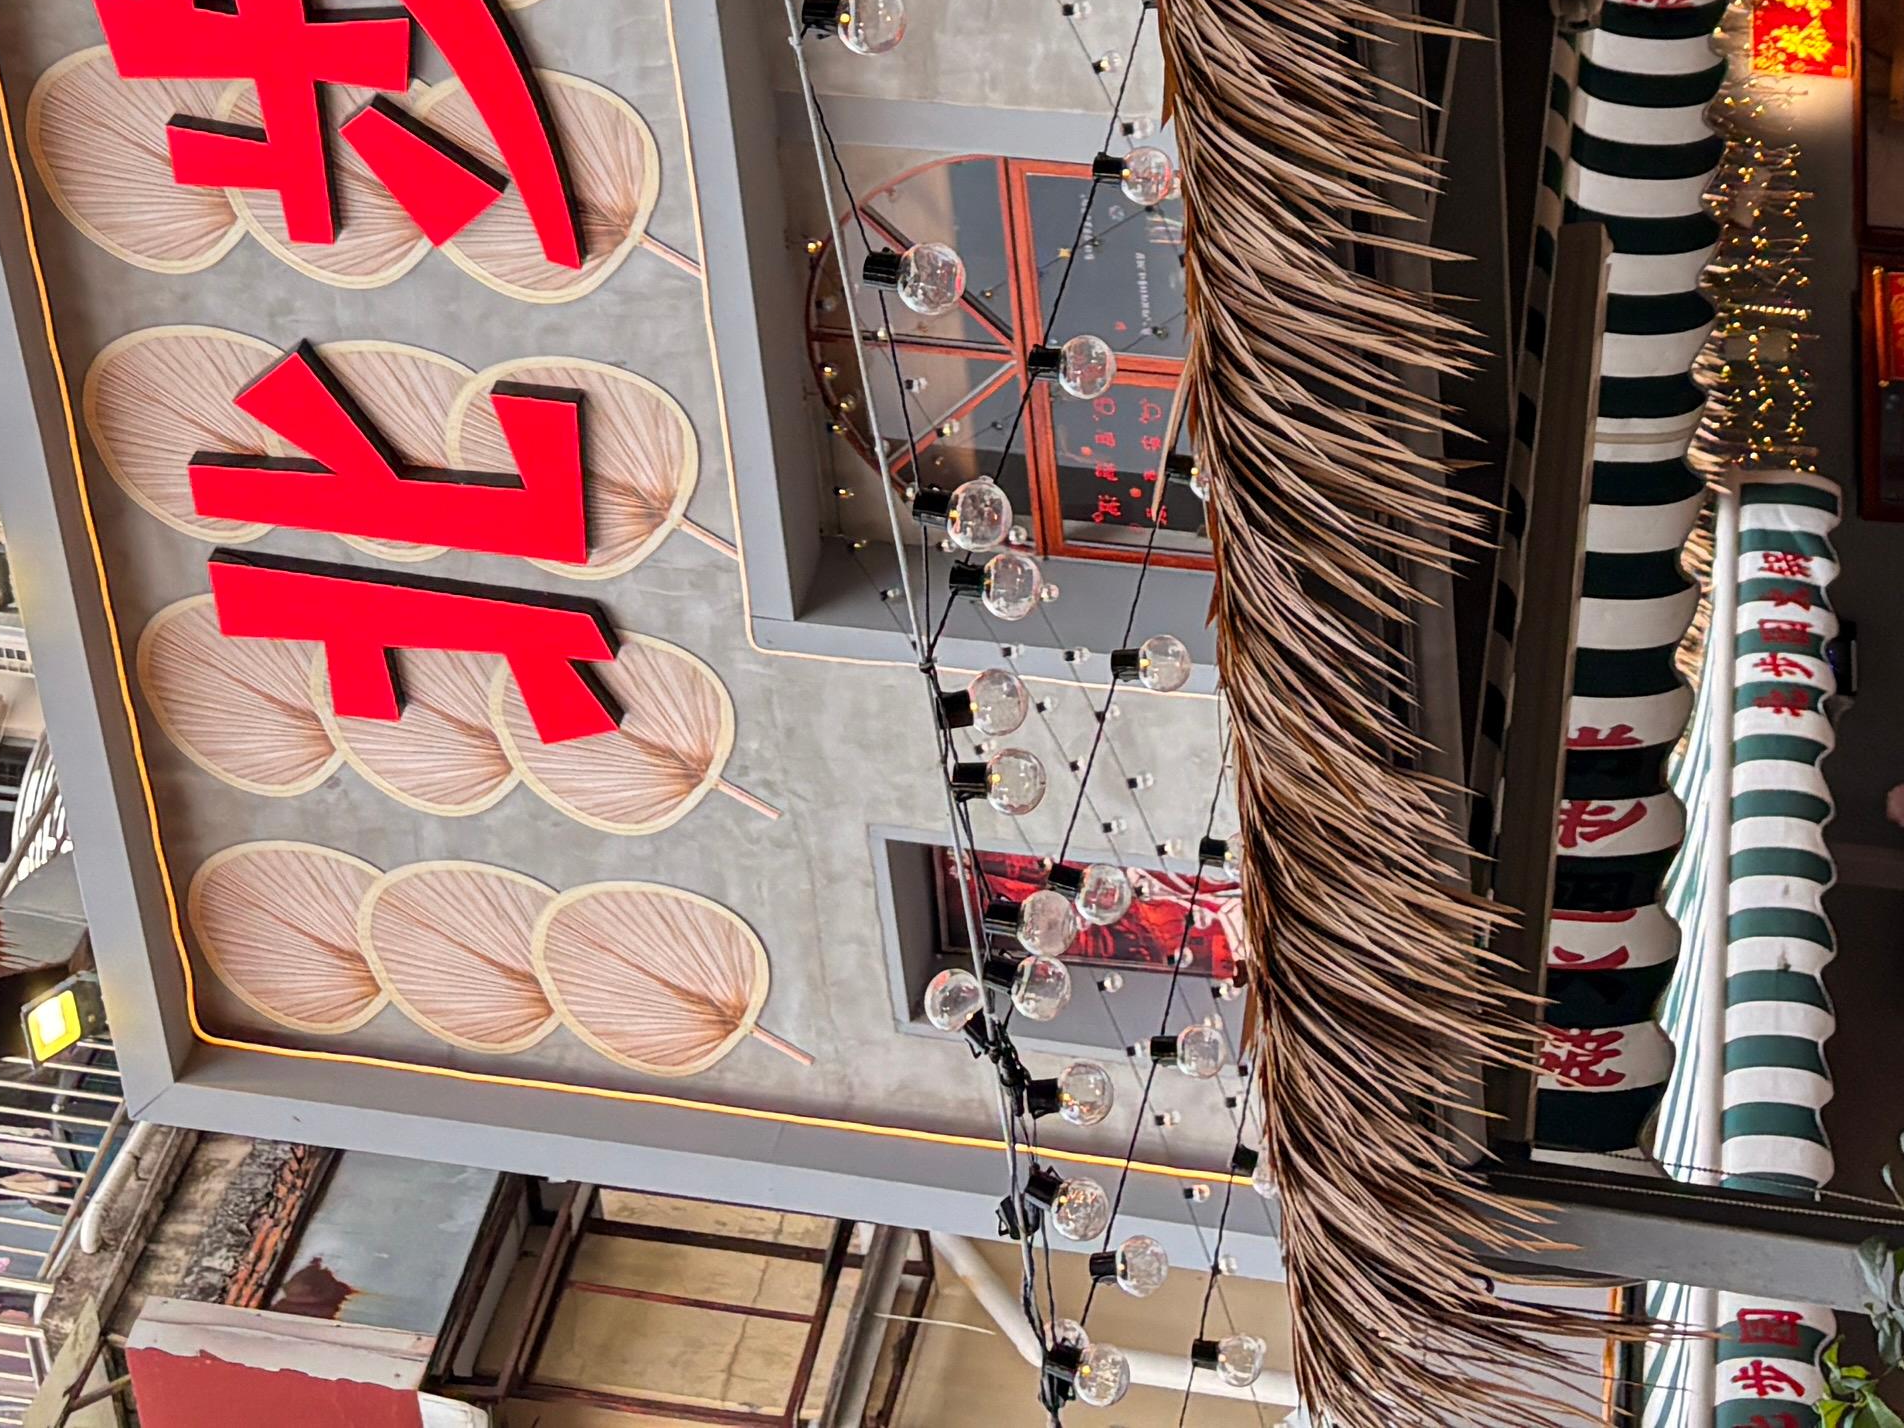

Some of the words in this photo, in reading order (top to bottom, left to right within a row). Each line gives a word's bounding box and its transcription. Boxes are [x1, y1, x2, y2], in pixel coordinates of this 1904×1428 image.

[1752, 550, 1815, 717] 北步园火锅
